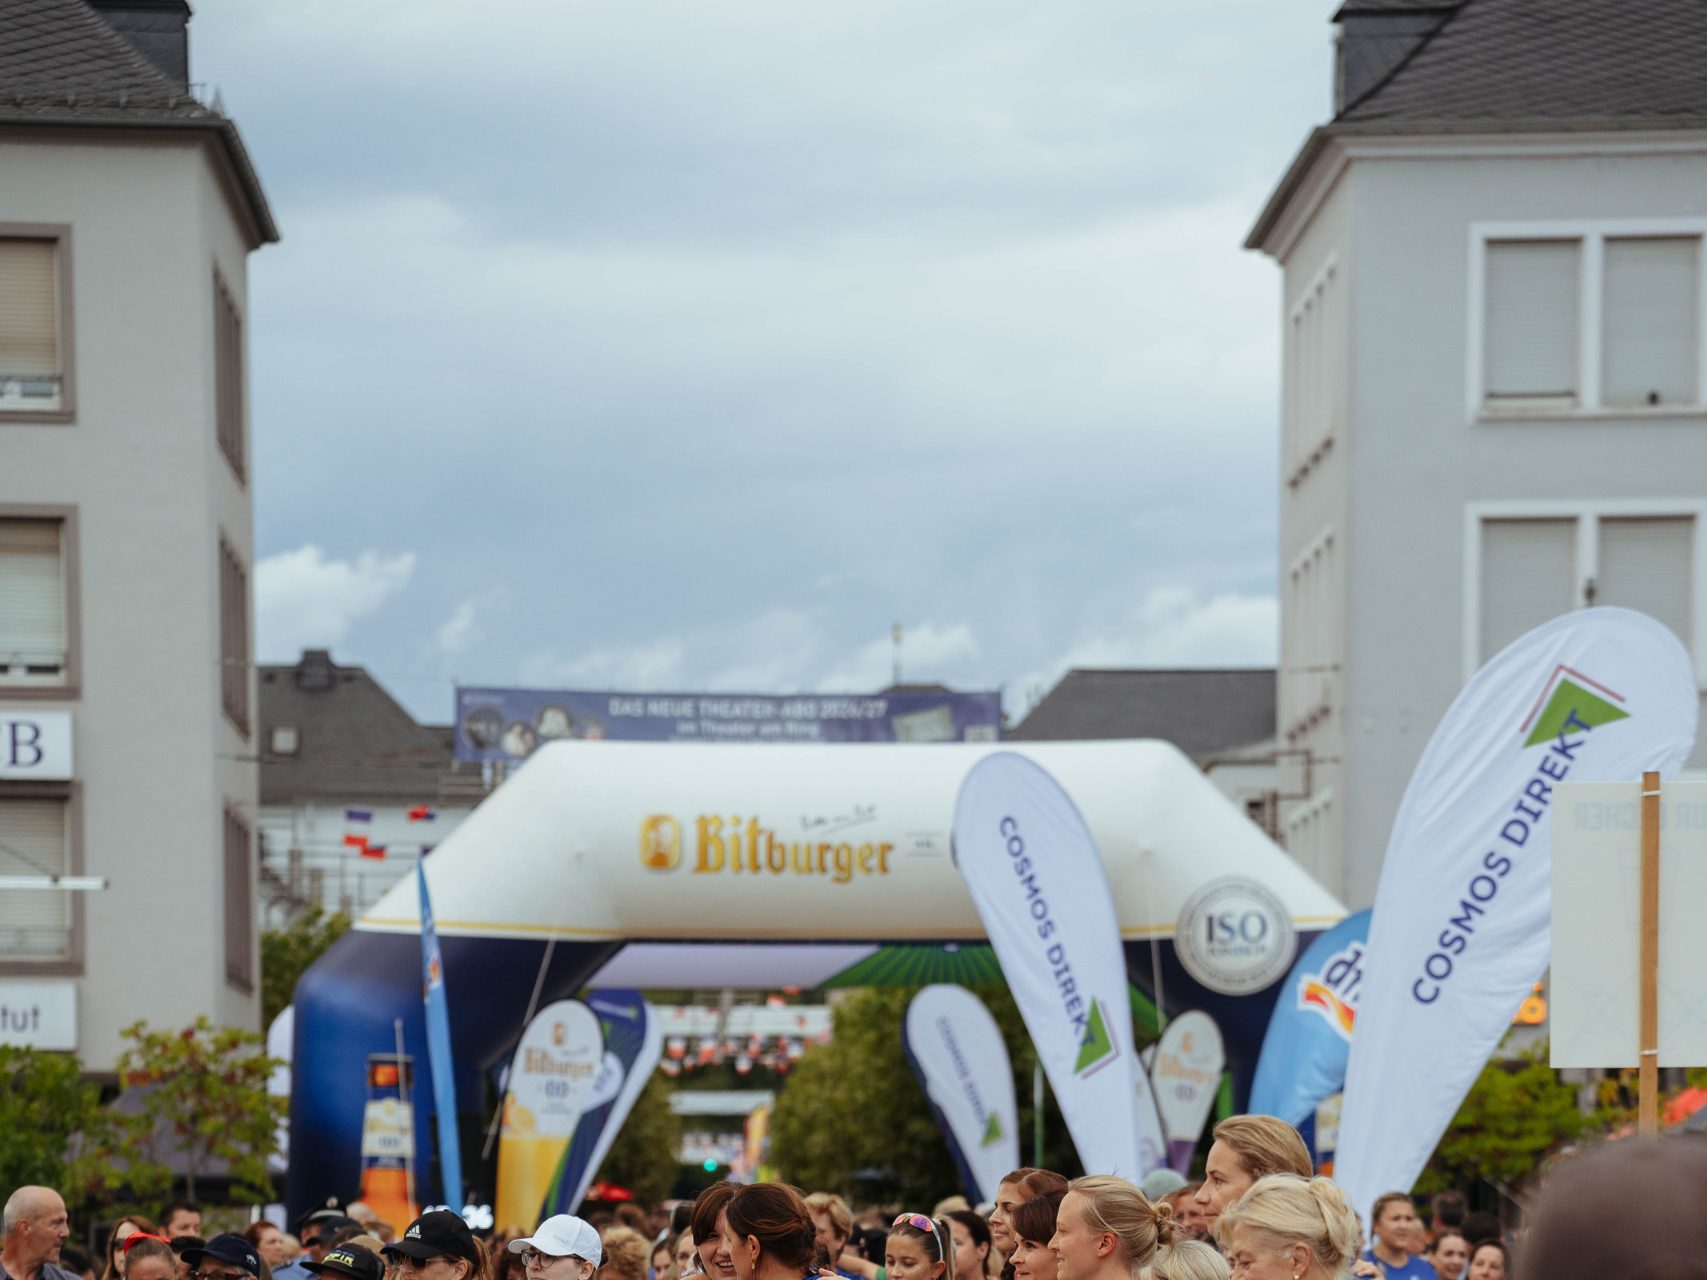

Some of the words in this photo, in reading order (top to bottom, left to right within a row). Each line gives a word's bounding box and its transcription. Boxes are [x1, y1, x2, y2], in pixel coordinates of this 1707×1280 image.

[693, 814, 895, 884] Bitburger
[1412, 851, 1512, 1005] COSMOS
[1499, 708, 1593, 847] DIREKT
[1000, 815, 1056, 940] COSMOS
[1046, 943, 1096, 1048] DIREKT
[1206, 911, 1268, 944] ISO
